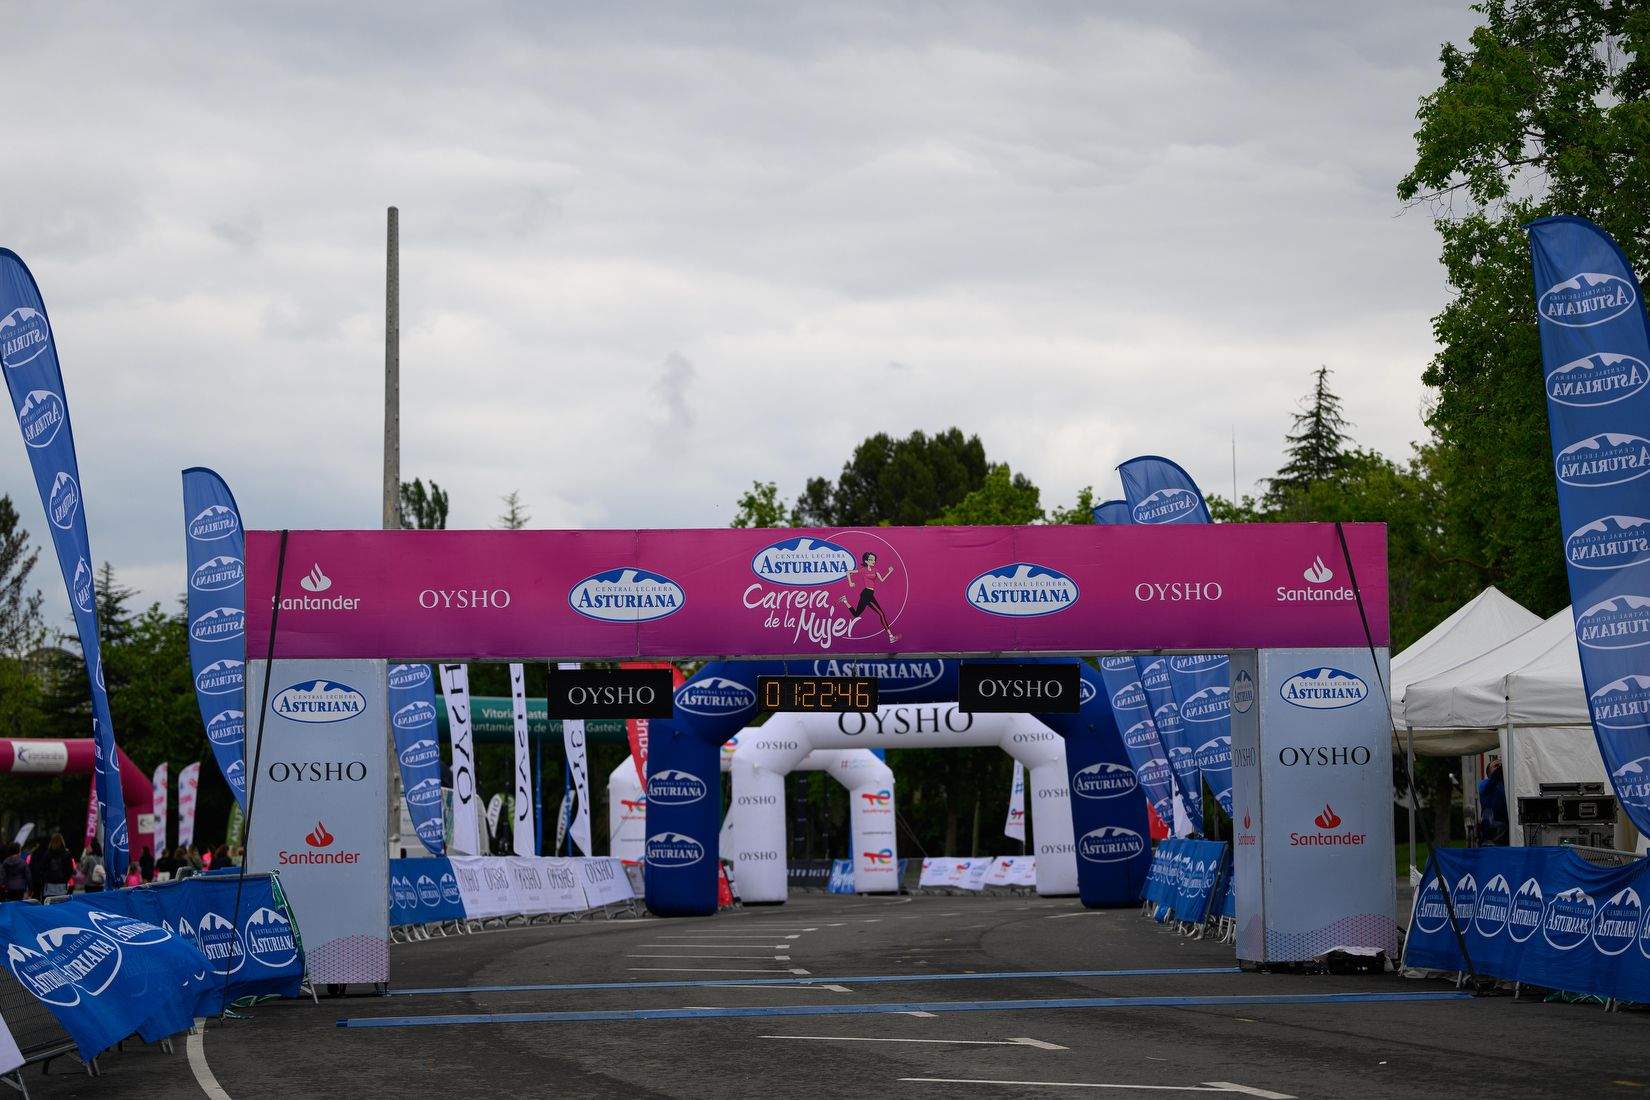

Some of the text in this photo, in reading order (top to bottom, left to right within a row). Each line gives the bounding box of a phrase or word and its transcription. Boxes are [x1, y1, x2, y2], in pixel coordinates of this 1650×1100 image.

[759, 555, 848, 574] ASTURIANA
[418, 589, 511, 609] OYSHO
[578, 587, 677, 609] ASTURIANA
[742, 583, 829, 609] Carrera
[975, 583, 1070, 603] ASTURIANA
[1134, 582, 1223, 602] OYSHO
[764, 606, 861, 649] de la Mujer
[826, 659, 934, 679] ASTURIANA
[567, 686, 655, 706] OYSHO
[978, 679, 1063, 698] OYSHO
[1287, 683, 1362, 700] ASTURIANA
[278, 695, 359, 712] ASTURIANA
[680, 692, 749, 707] ASTURIANA
[838, 706, 974, 736] OYSHO
[756, 741, 798, 751] OYSHO
[1012, 732, 1054, 743] OYSHO
[1278, 746, 1371, 767] OYSHO
[268, 761, 367, 783] OYSHO
[648, 780, 701, 797] ASTURIANA
[1076, 776, 1135, 791] ASTURIANA
[737, 795, 776, 806] OYSHO
[1038, 788, 1070, 799] OYSH
[1082, 840, 1140, 855] ASTURIANA
[1290, 832, 1366, 846] Santander
[278, 850, 360, 865] Santander
[647, 845, 699, 859] ASTURIANA
[739, 851, 778, 861] OYSHO
[1545, 905, 1589, 935] ASTURIANA
[1594, 910, 1637, 938] ASTURIANA
